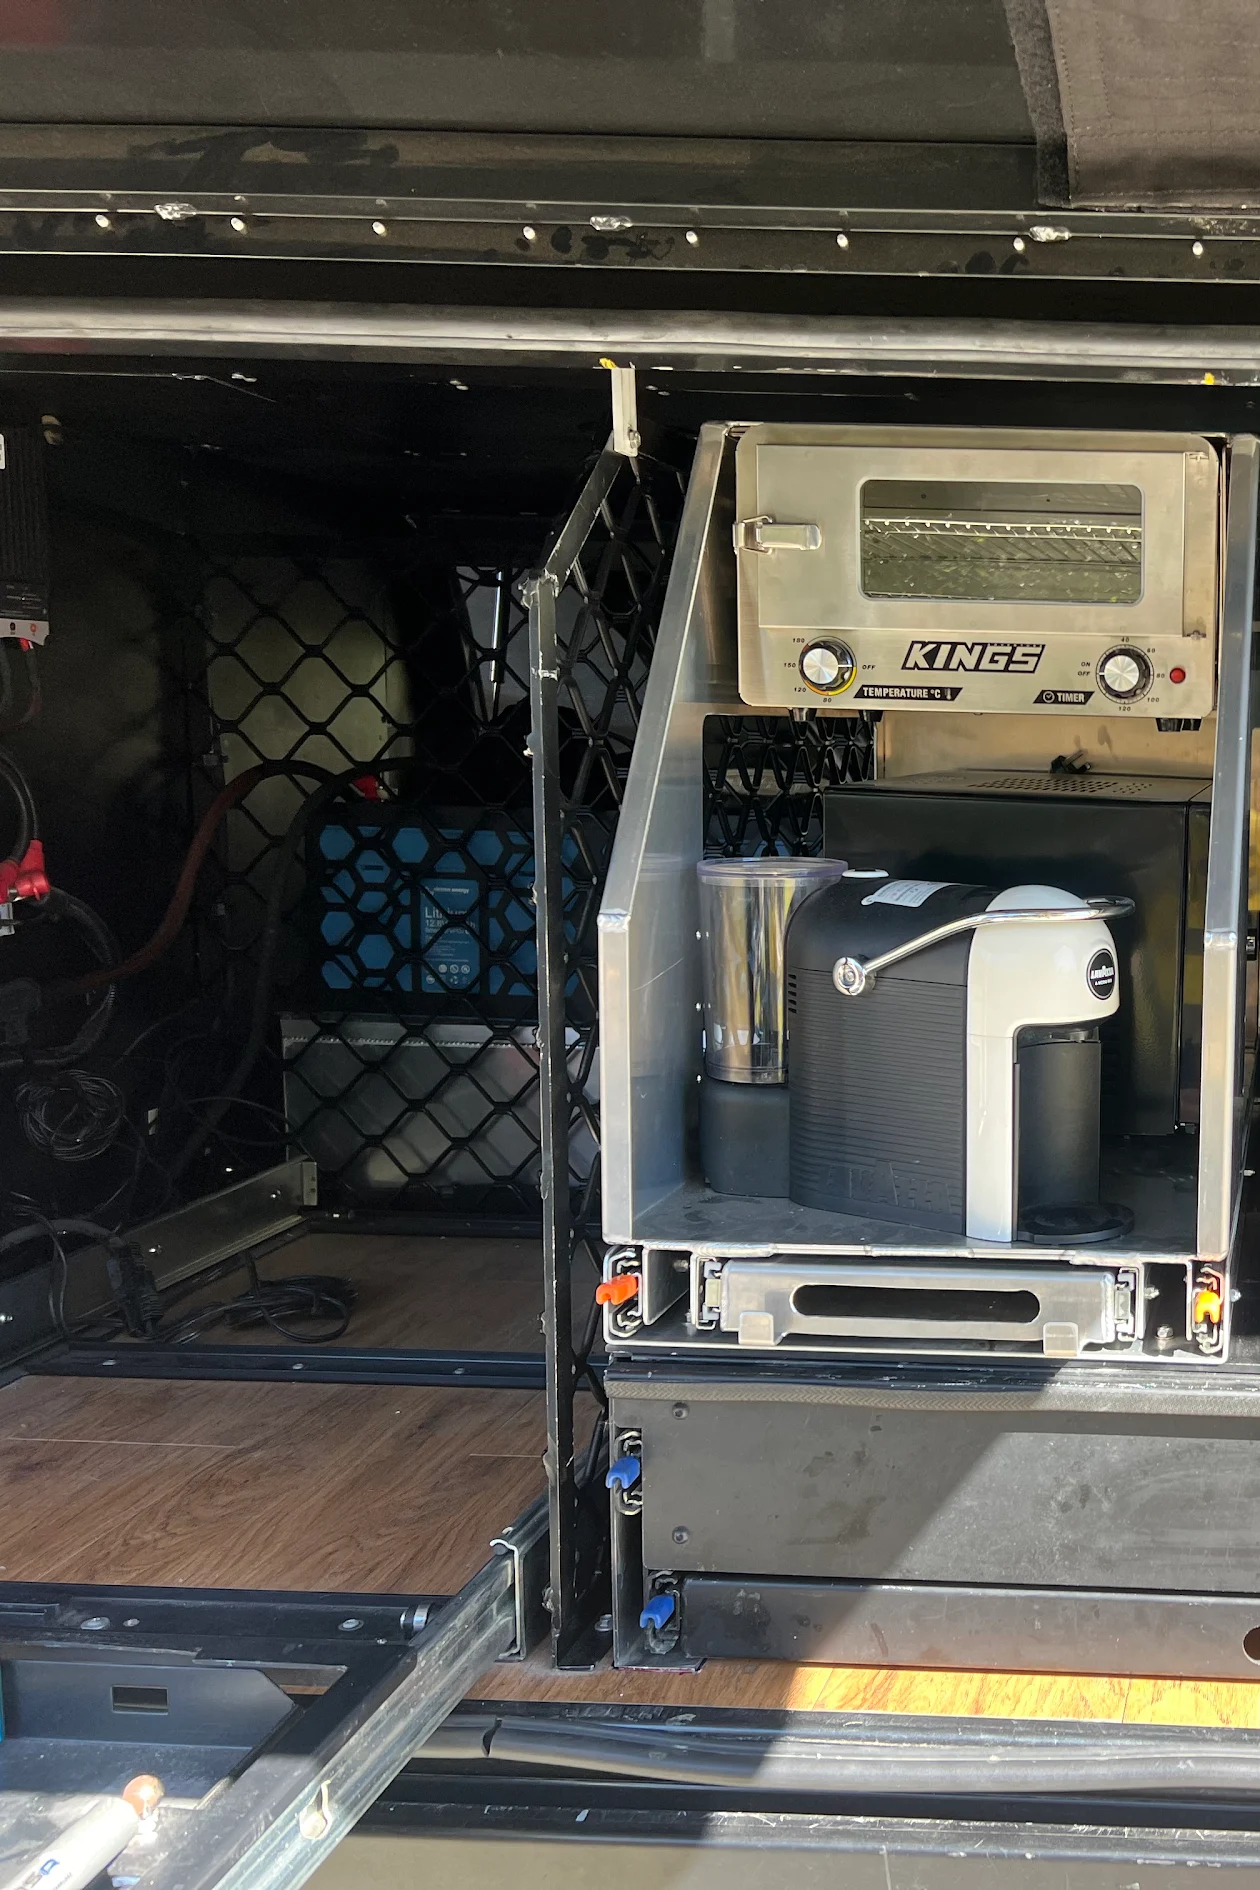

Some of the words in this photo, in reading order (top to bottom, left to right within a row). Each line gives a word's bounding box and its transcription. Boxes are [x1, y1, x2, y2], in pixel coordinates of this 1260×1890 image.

[902, 641, 1045, 673] KINGS
[862, 687, 928, 698] TEMPERATURE
[1057, 692, 1085, 703] TIMER
